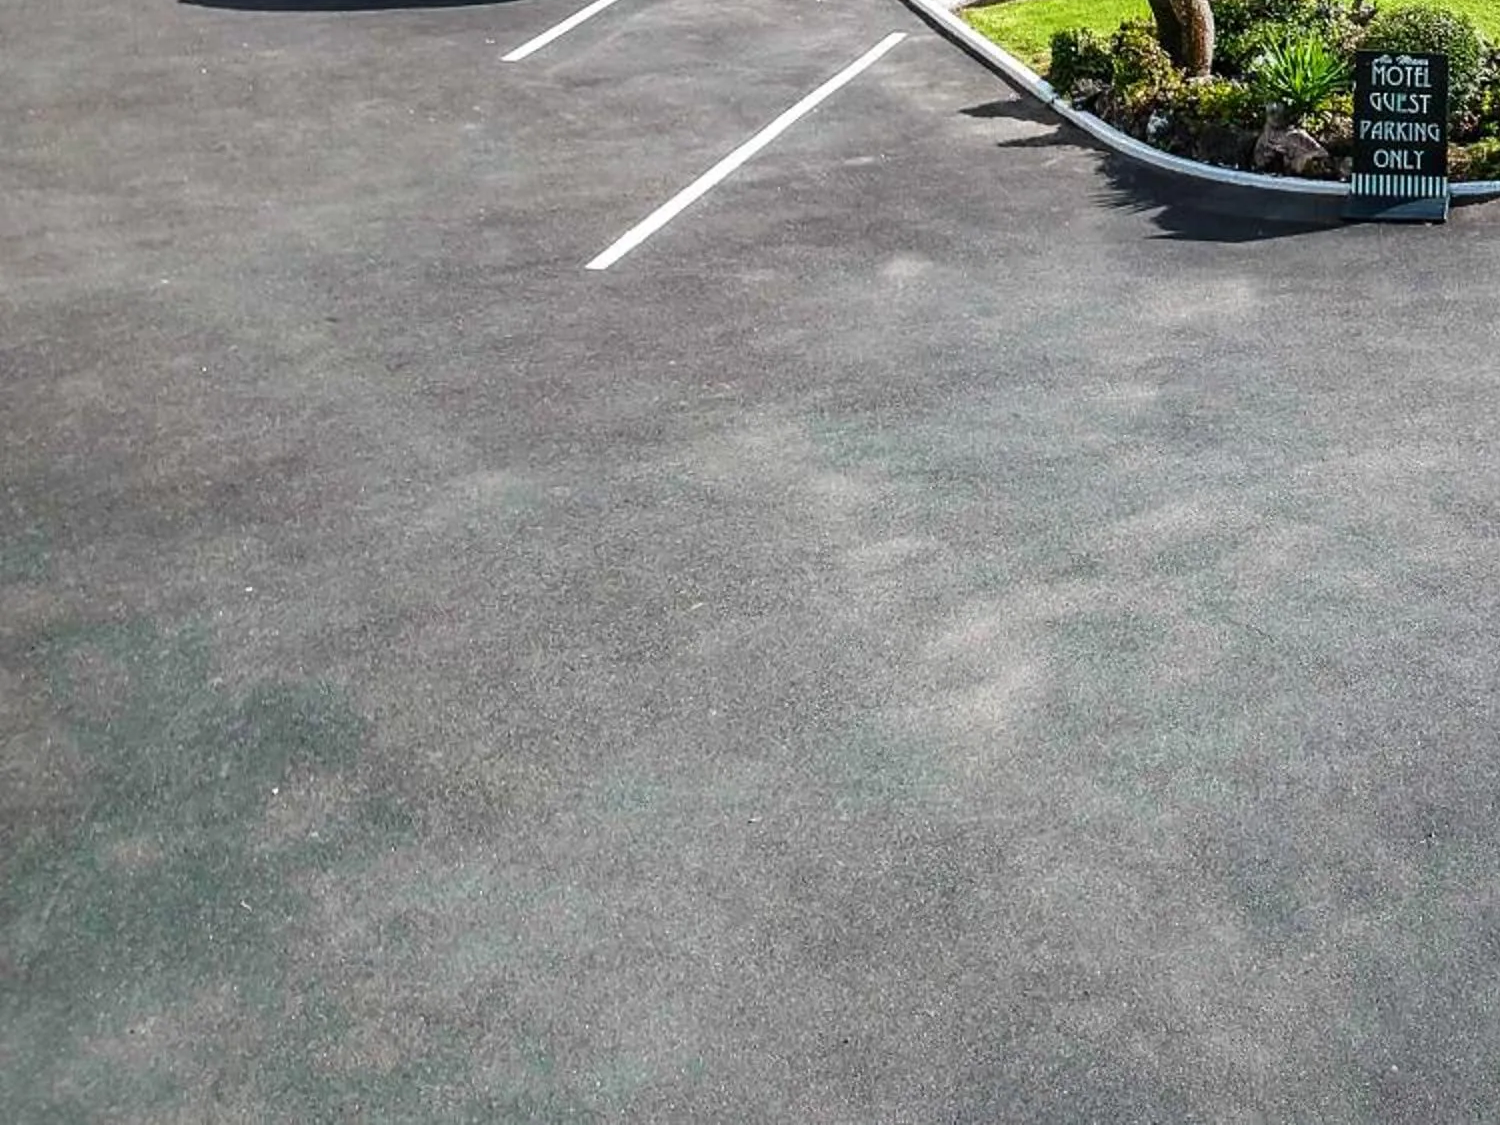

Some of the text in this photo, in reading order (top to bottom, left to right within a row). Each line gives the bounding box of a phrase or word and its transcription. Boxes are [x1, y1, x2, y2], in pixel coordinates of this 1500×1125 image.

[1371, 65, 1432, 87] MOTEL
[1369, 92, 1432, 114] GUEST
[1359, 120, 1440, 142] PARKING
[1373, 149, 1425, 170] ONLY
